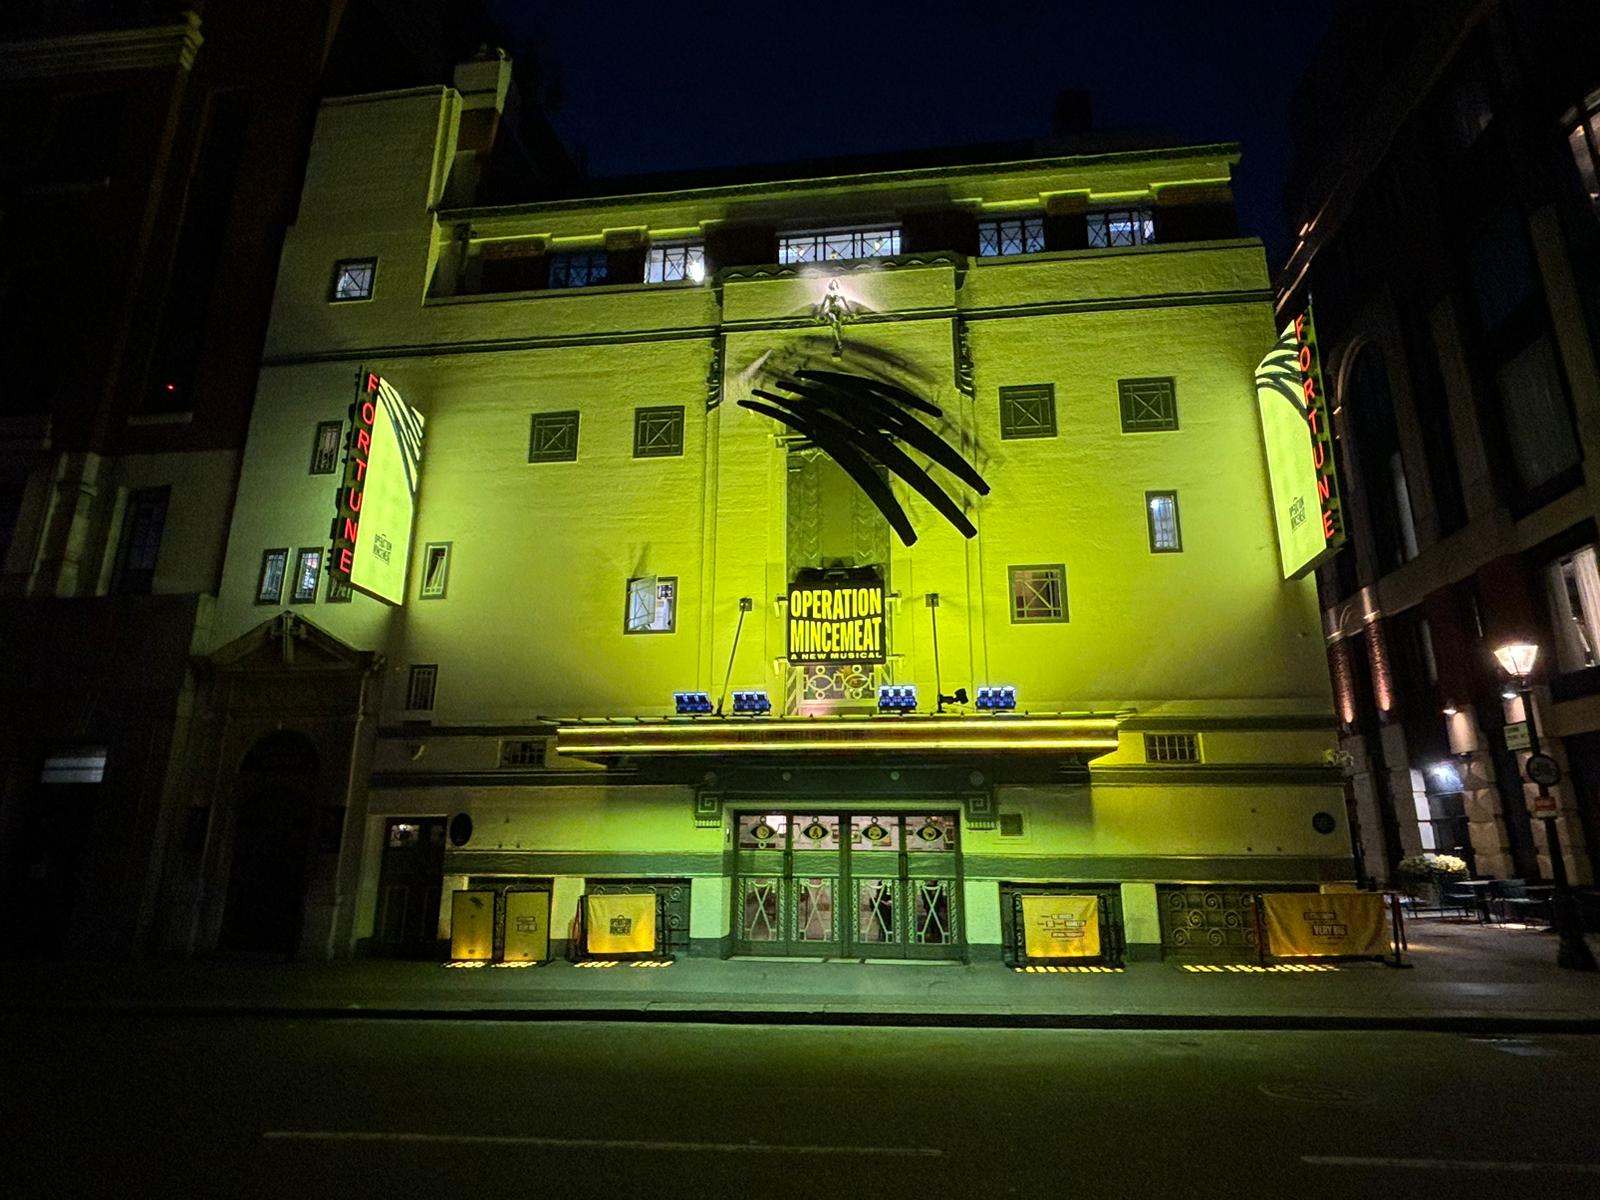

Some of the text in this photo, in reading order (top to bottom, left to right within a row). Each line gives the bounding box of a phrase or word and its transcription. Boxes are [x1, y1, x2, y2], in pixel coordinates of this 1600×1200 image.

[340, 373, 379, 574] FORTUNE
[1296, 313, 1335, 538] FORTUNE
[790, 588, 882, 620] OPERATION
[790, 617, 882, 653] MINCEMEAT
